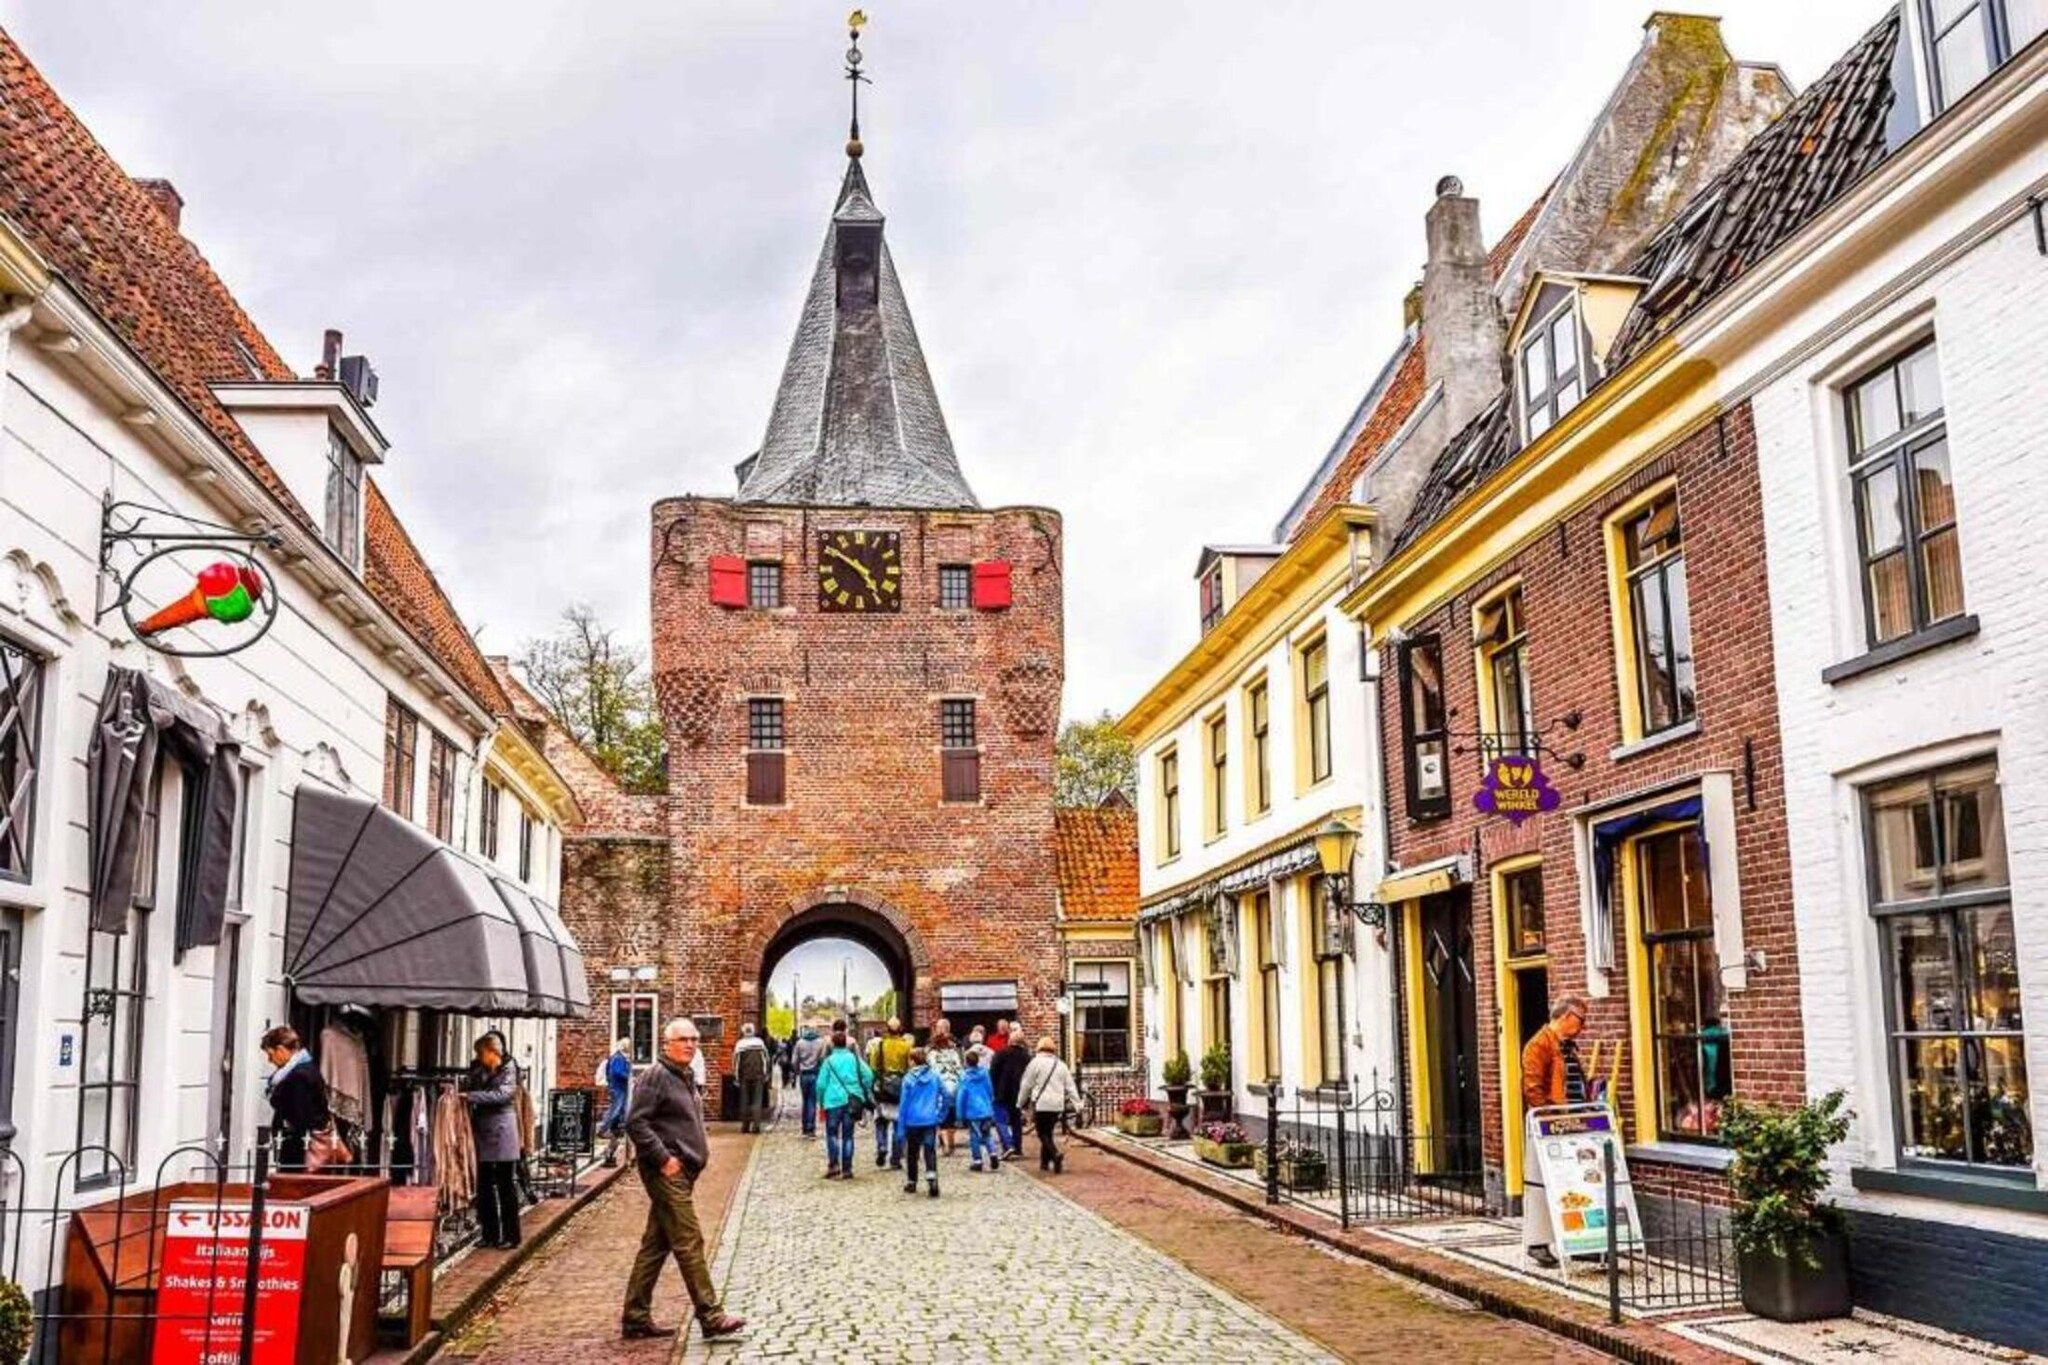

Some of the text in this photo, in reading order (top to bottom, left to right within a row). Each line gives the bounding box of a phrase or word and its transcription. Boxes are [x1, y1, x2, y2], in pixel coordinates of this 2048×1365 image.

[1494, 788, 1539, 800] WERELD
[195, 1242, 254, 1257] Italiaan
[163, 1275, 300, 1291] Shakes & Smothies
[209, 1311, 247, 1326] offi
[199, 1350, 243, 1365] oftij
